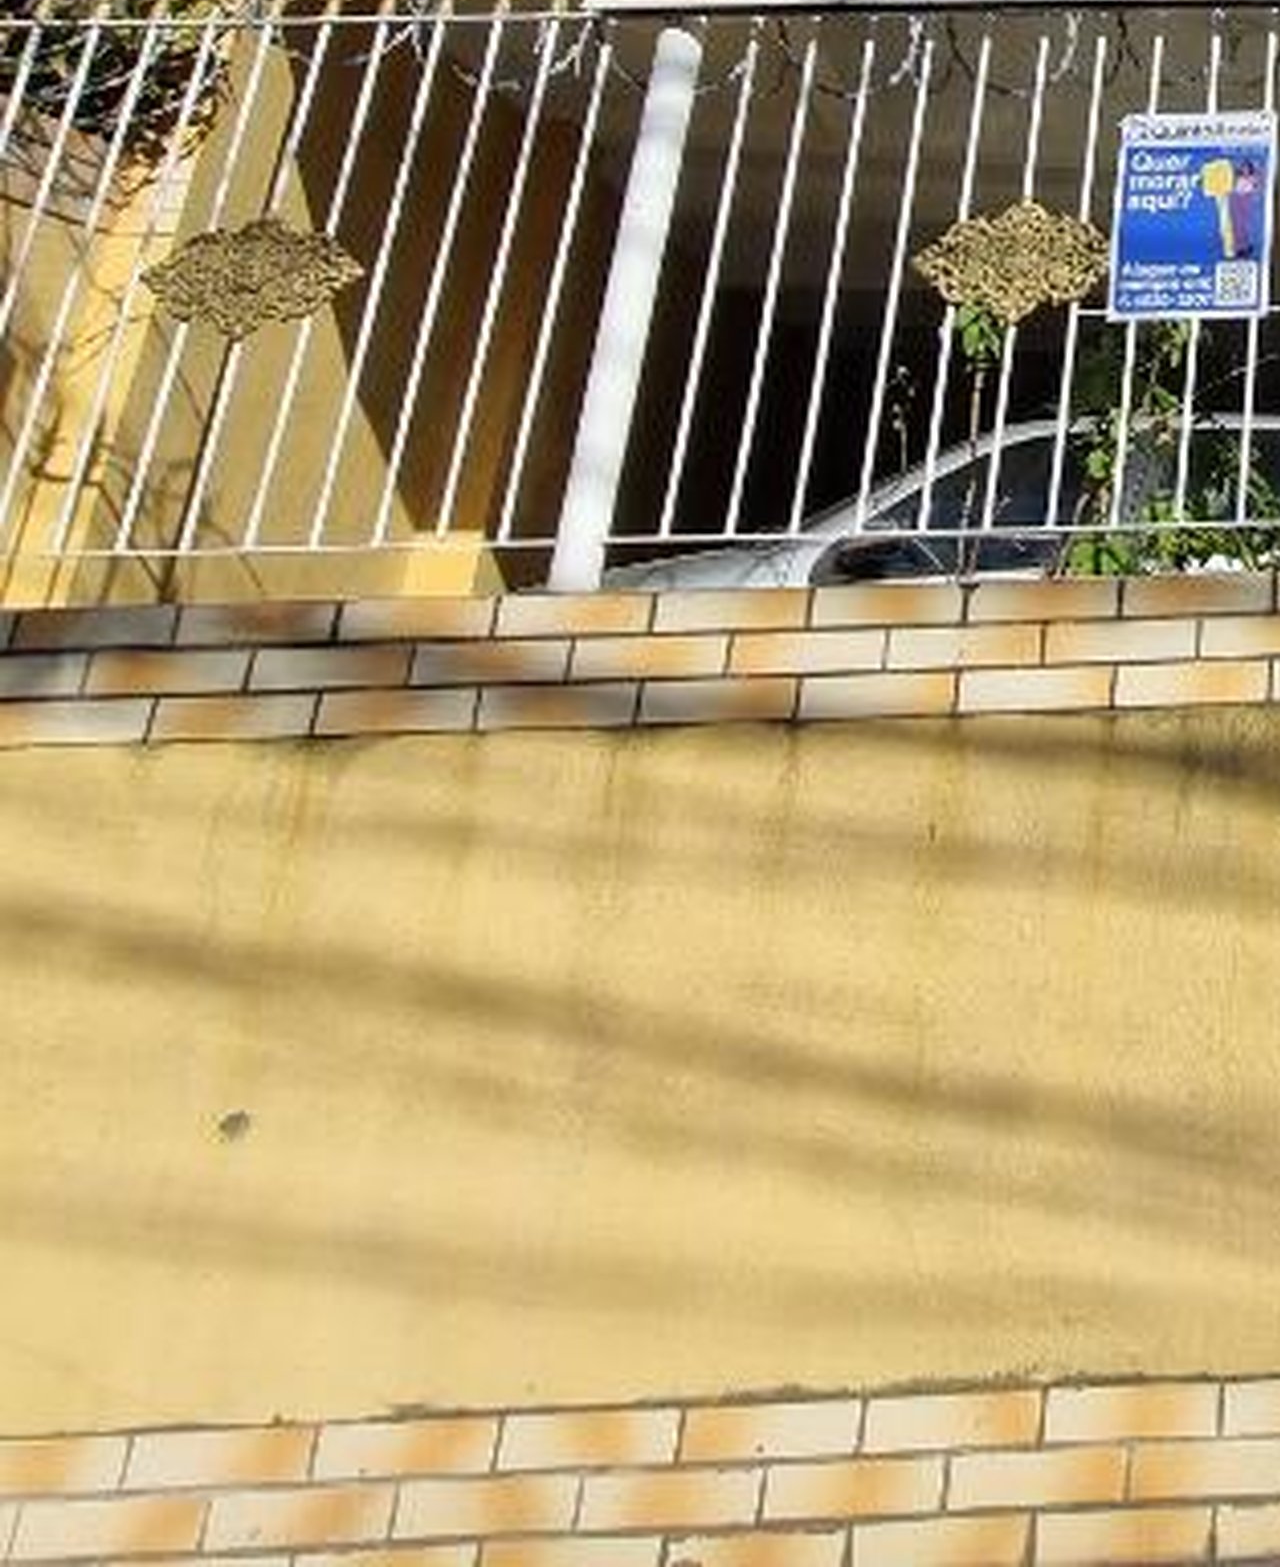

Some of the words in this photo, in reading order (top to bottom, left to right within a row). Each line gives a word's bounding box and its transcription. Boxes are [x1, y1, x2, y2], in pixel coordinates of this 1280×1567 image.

[1129, 150, 1193, 172] Quer
[1129, 174, 1201, 191] morar
[1126, 190, 1193, 214] aqui?
